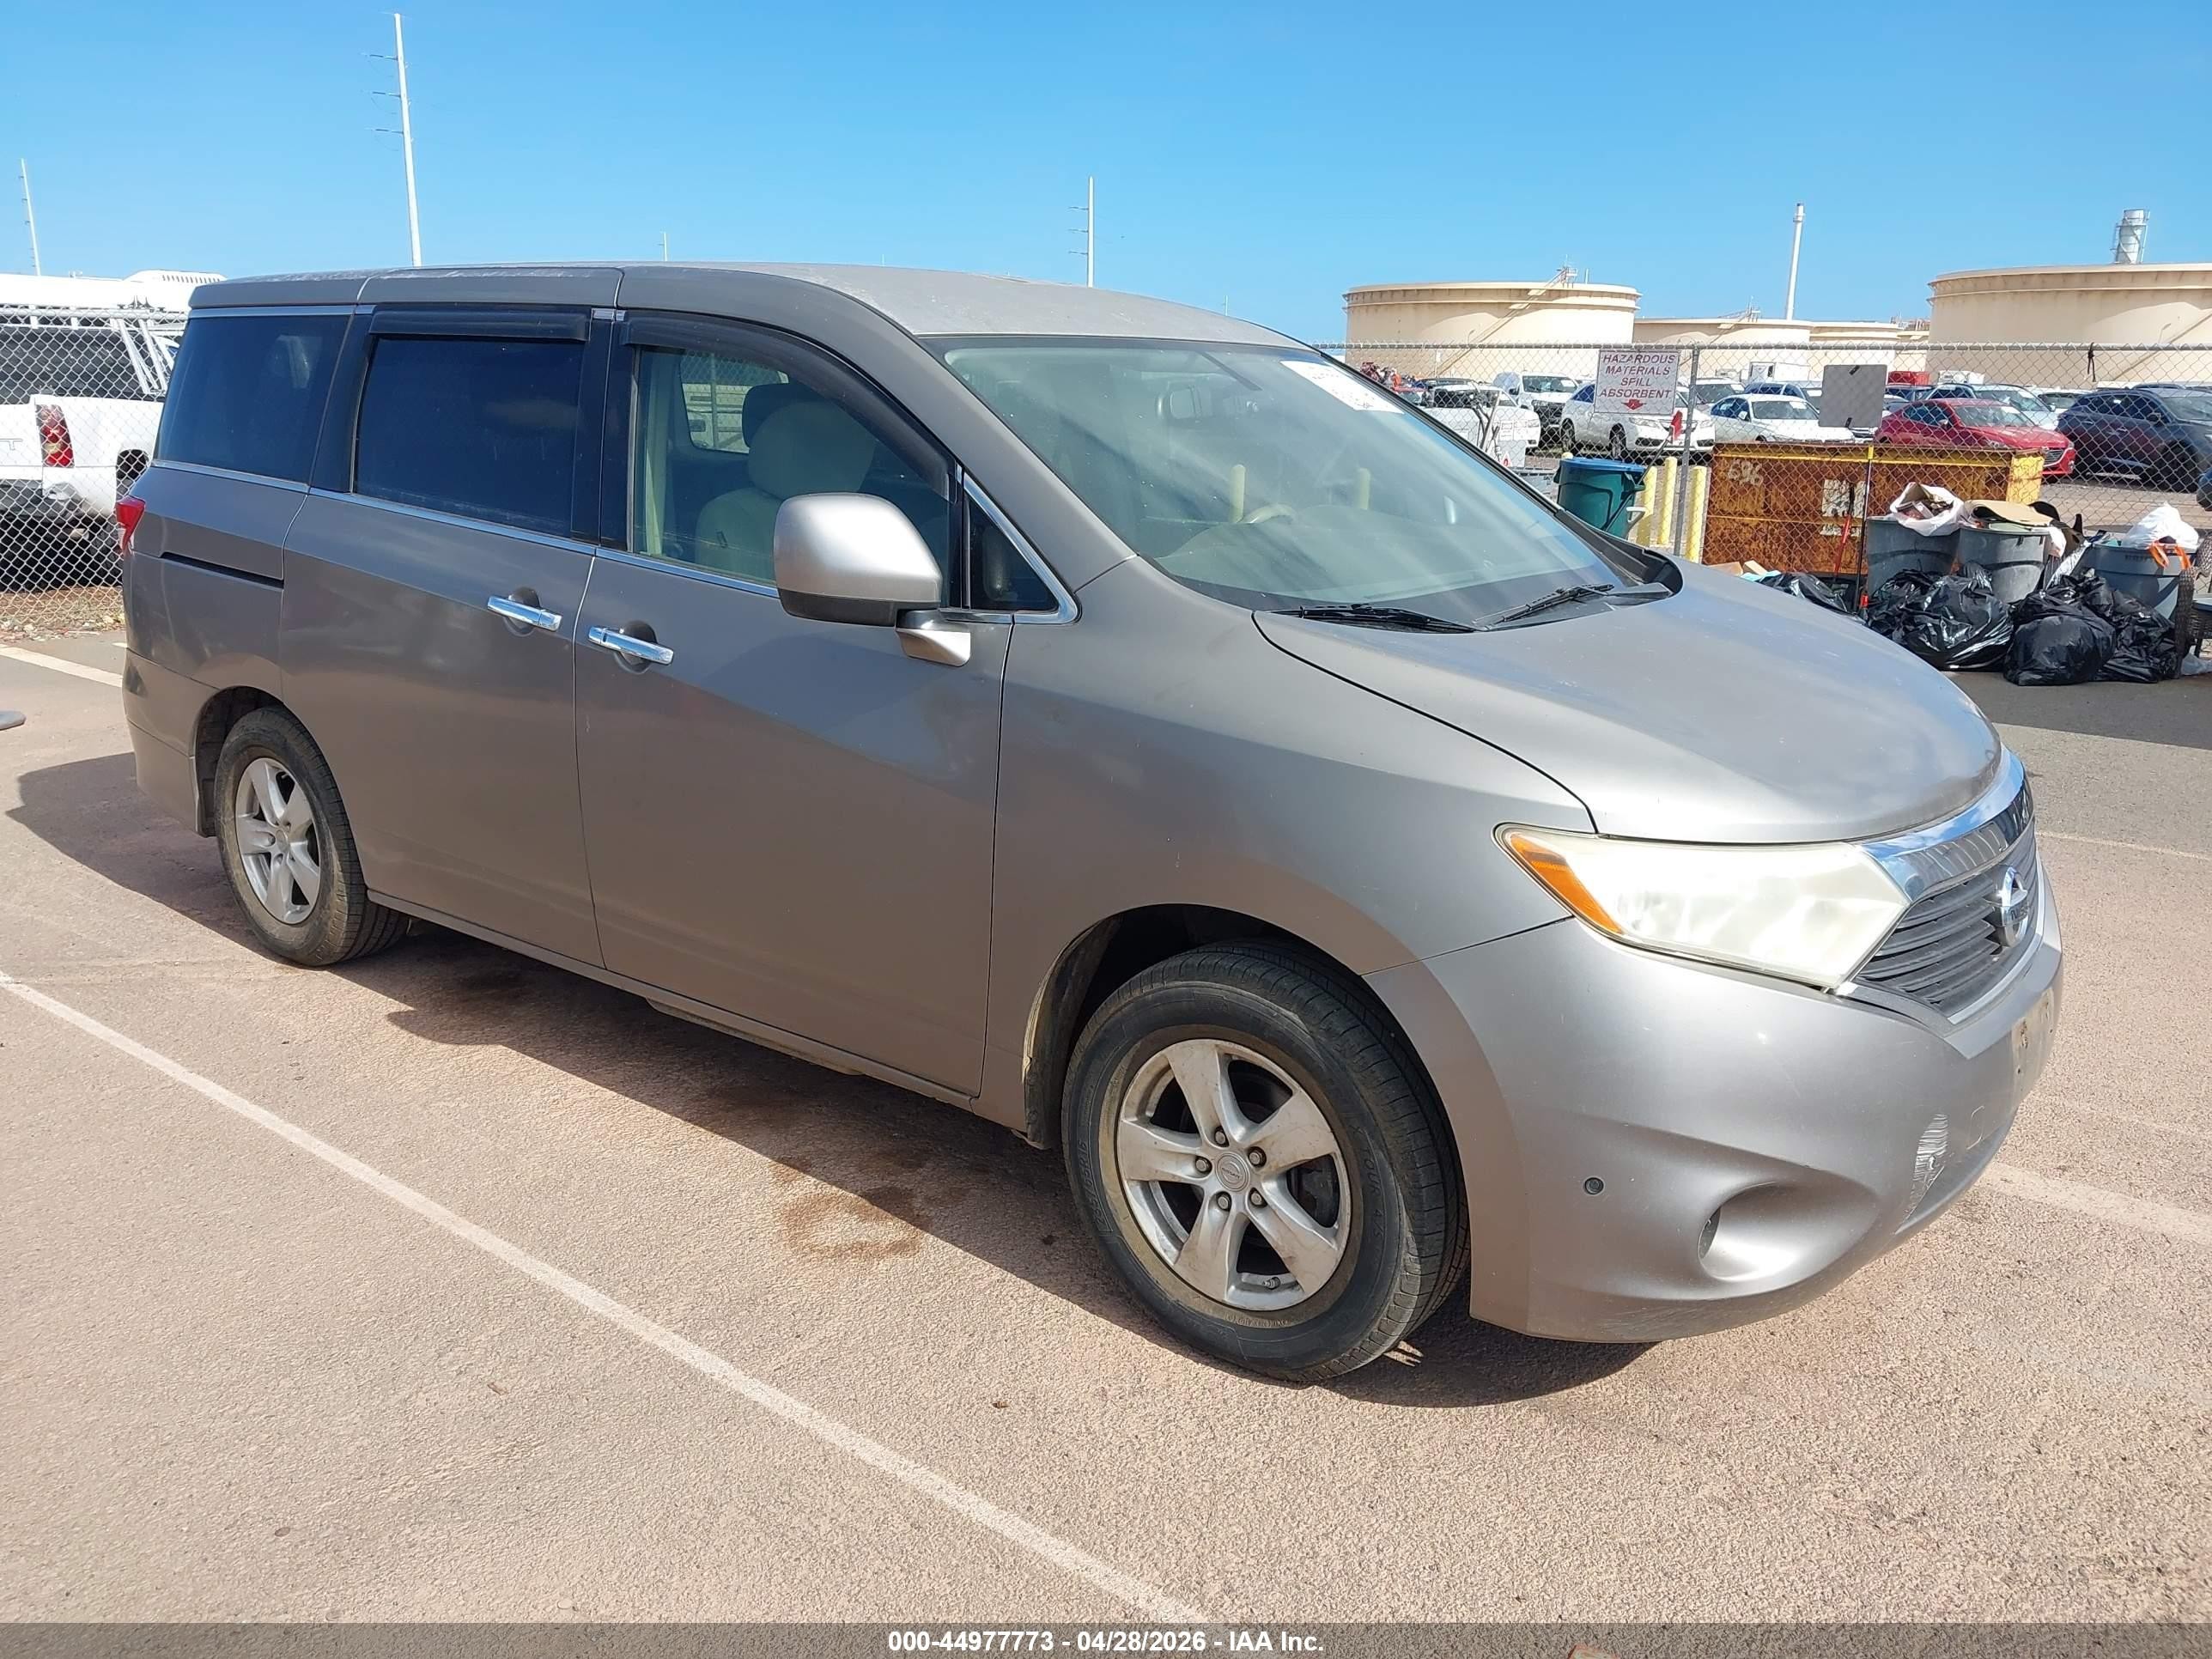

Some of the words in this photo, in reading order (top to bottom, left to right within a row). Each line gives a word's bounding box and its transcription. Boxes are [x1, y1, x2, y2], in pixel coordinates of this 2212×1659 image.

[1603, 354, 1675, 364] HAZARDOUS
[1606, 365, 1670, 375] MATERIALS
[1621, 378, 1651, 386] SPILL
[1600, 389, 1672, 398] ABSORBENT
